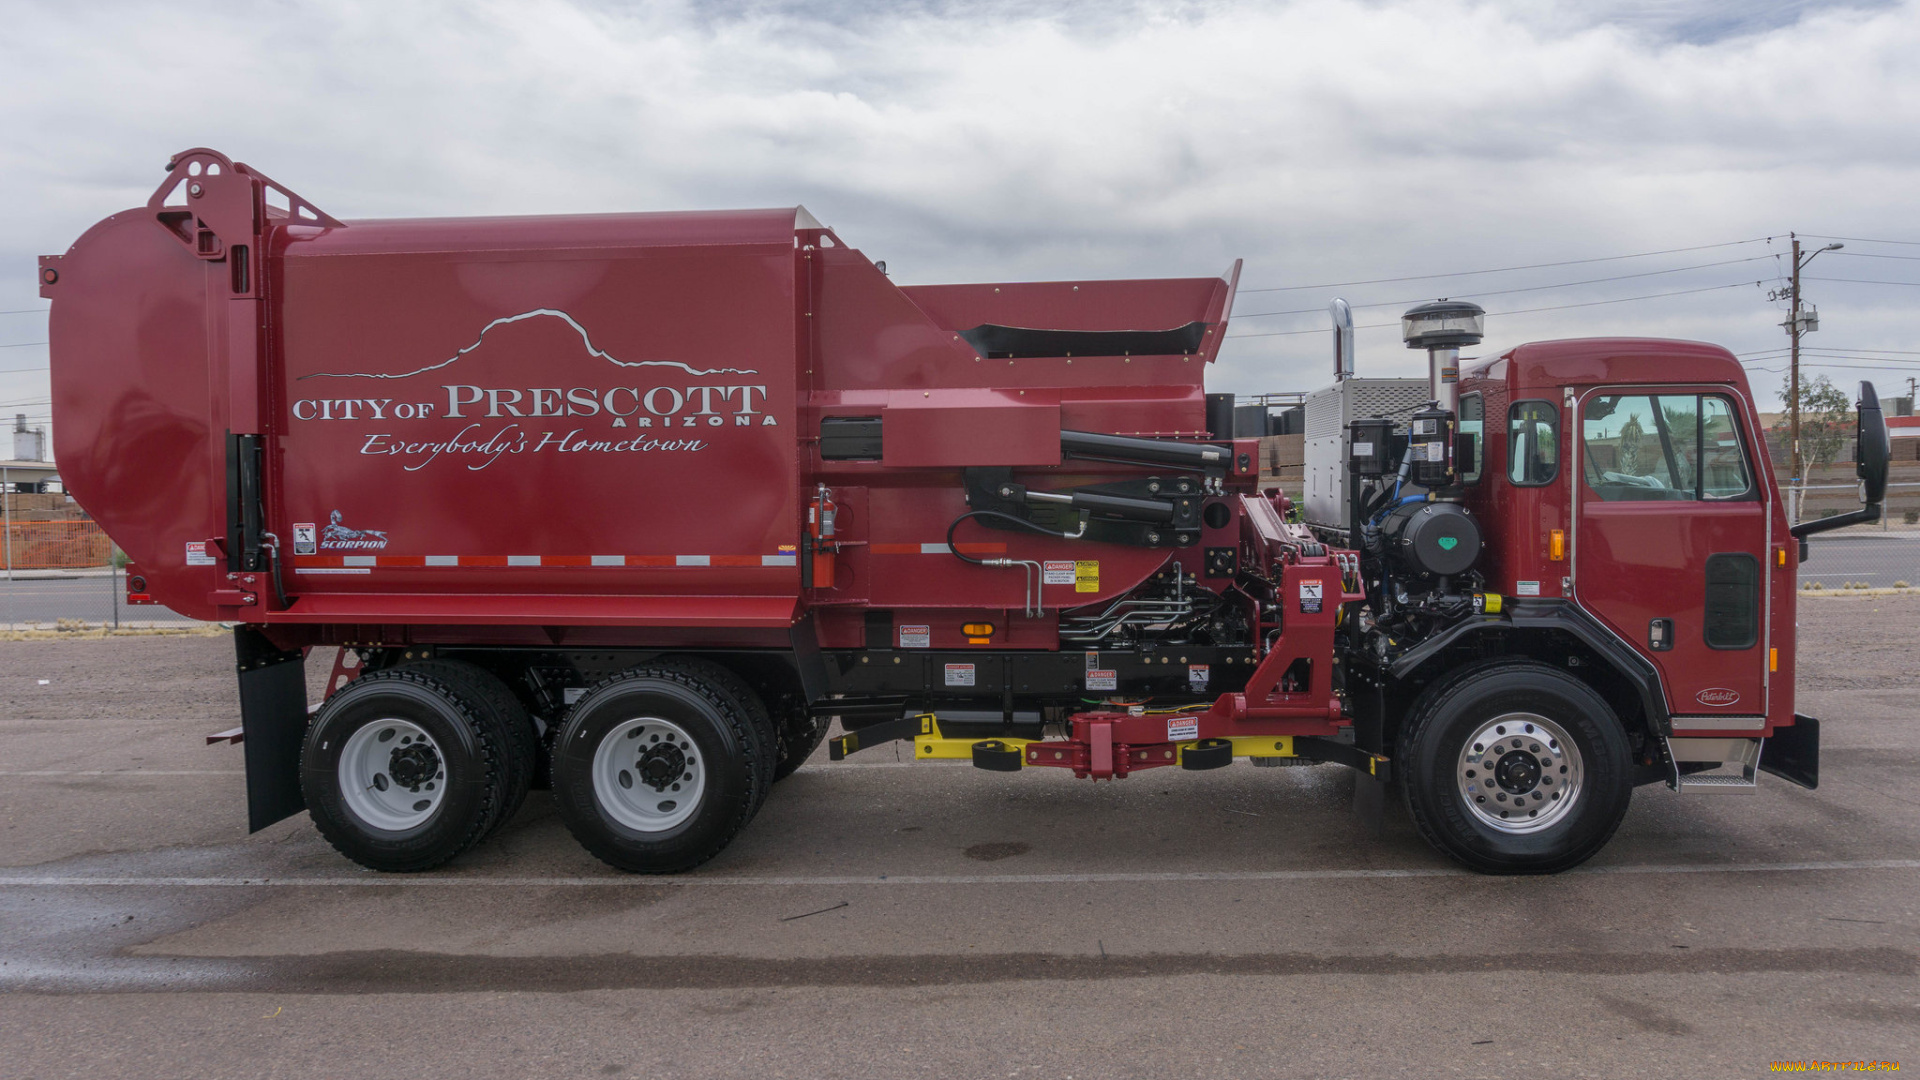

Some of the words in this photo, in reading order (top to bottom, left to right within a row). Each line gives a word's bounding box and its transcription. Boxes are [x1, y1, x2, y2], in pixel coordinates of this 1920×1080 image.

[292, 399, 393, 420] CITY
[394, 403, 435, 419] OF
[441, 385, 767, 419] PRESCOTT
[611, 415, 778, 428] ARIZONA
[360, 423, 529, 471] Everybody's
[533, 428, 709, 453] Hometown
[320, 540, 387, 549] SCORPION
[1701, 692, 1736, 701] Peterbilt
